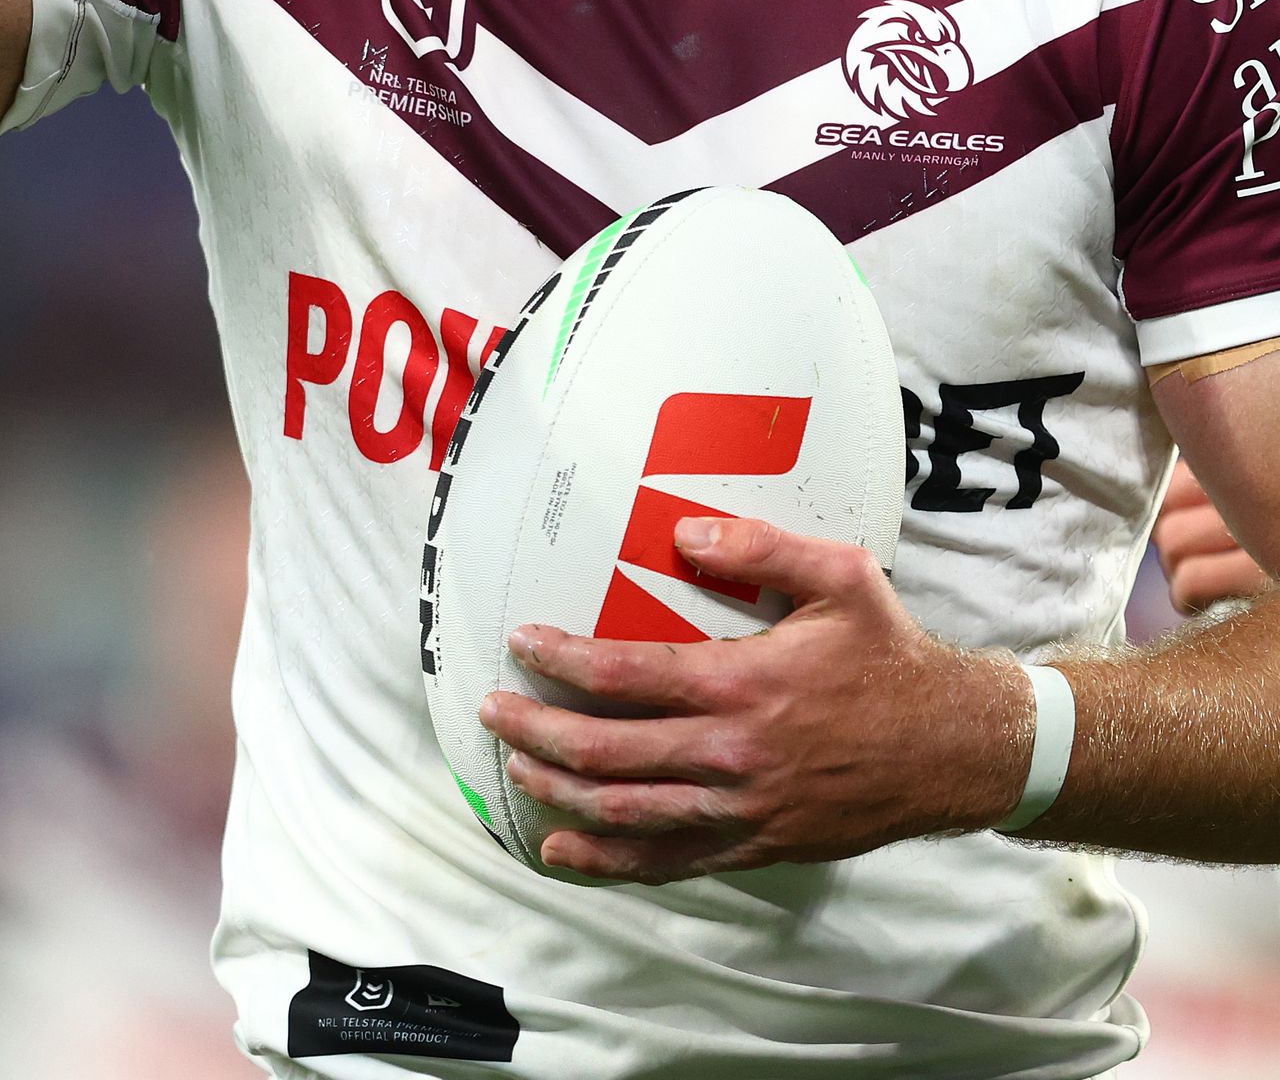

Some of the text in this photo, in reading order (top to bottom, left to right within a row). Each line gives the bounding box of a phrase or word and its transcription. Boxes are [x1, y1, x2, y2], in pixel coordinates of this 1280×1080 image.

[369, 68, 457, 106] NRL TELSTRA
[347, 80, 472, 128] PREMIERSHIP
[816, 123, 1006, 153] SEA EAGLES
[850, 150, 980, 168] MANLY WARRINGAH
[420, 272, 562, 677] STEEDEN
[550, 470, 562, 496] MADE
[540, 507, 551, 530] INDIA
[544, 490, 563, 538] SYNTHETIC
[318, 1018, 338, 1029] NRL
[342, 1017, 393, 1029] TELSTRA
[340, 1030, 450, 1045] OFFICIAL PRODUCT
